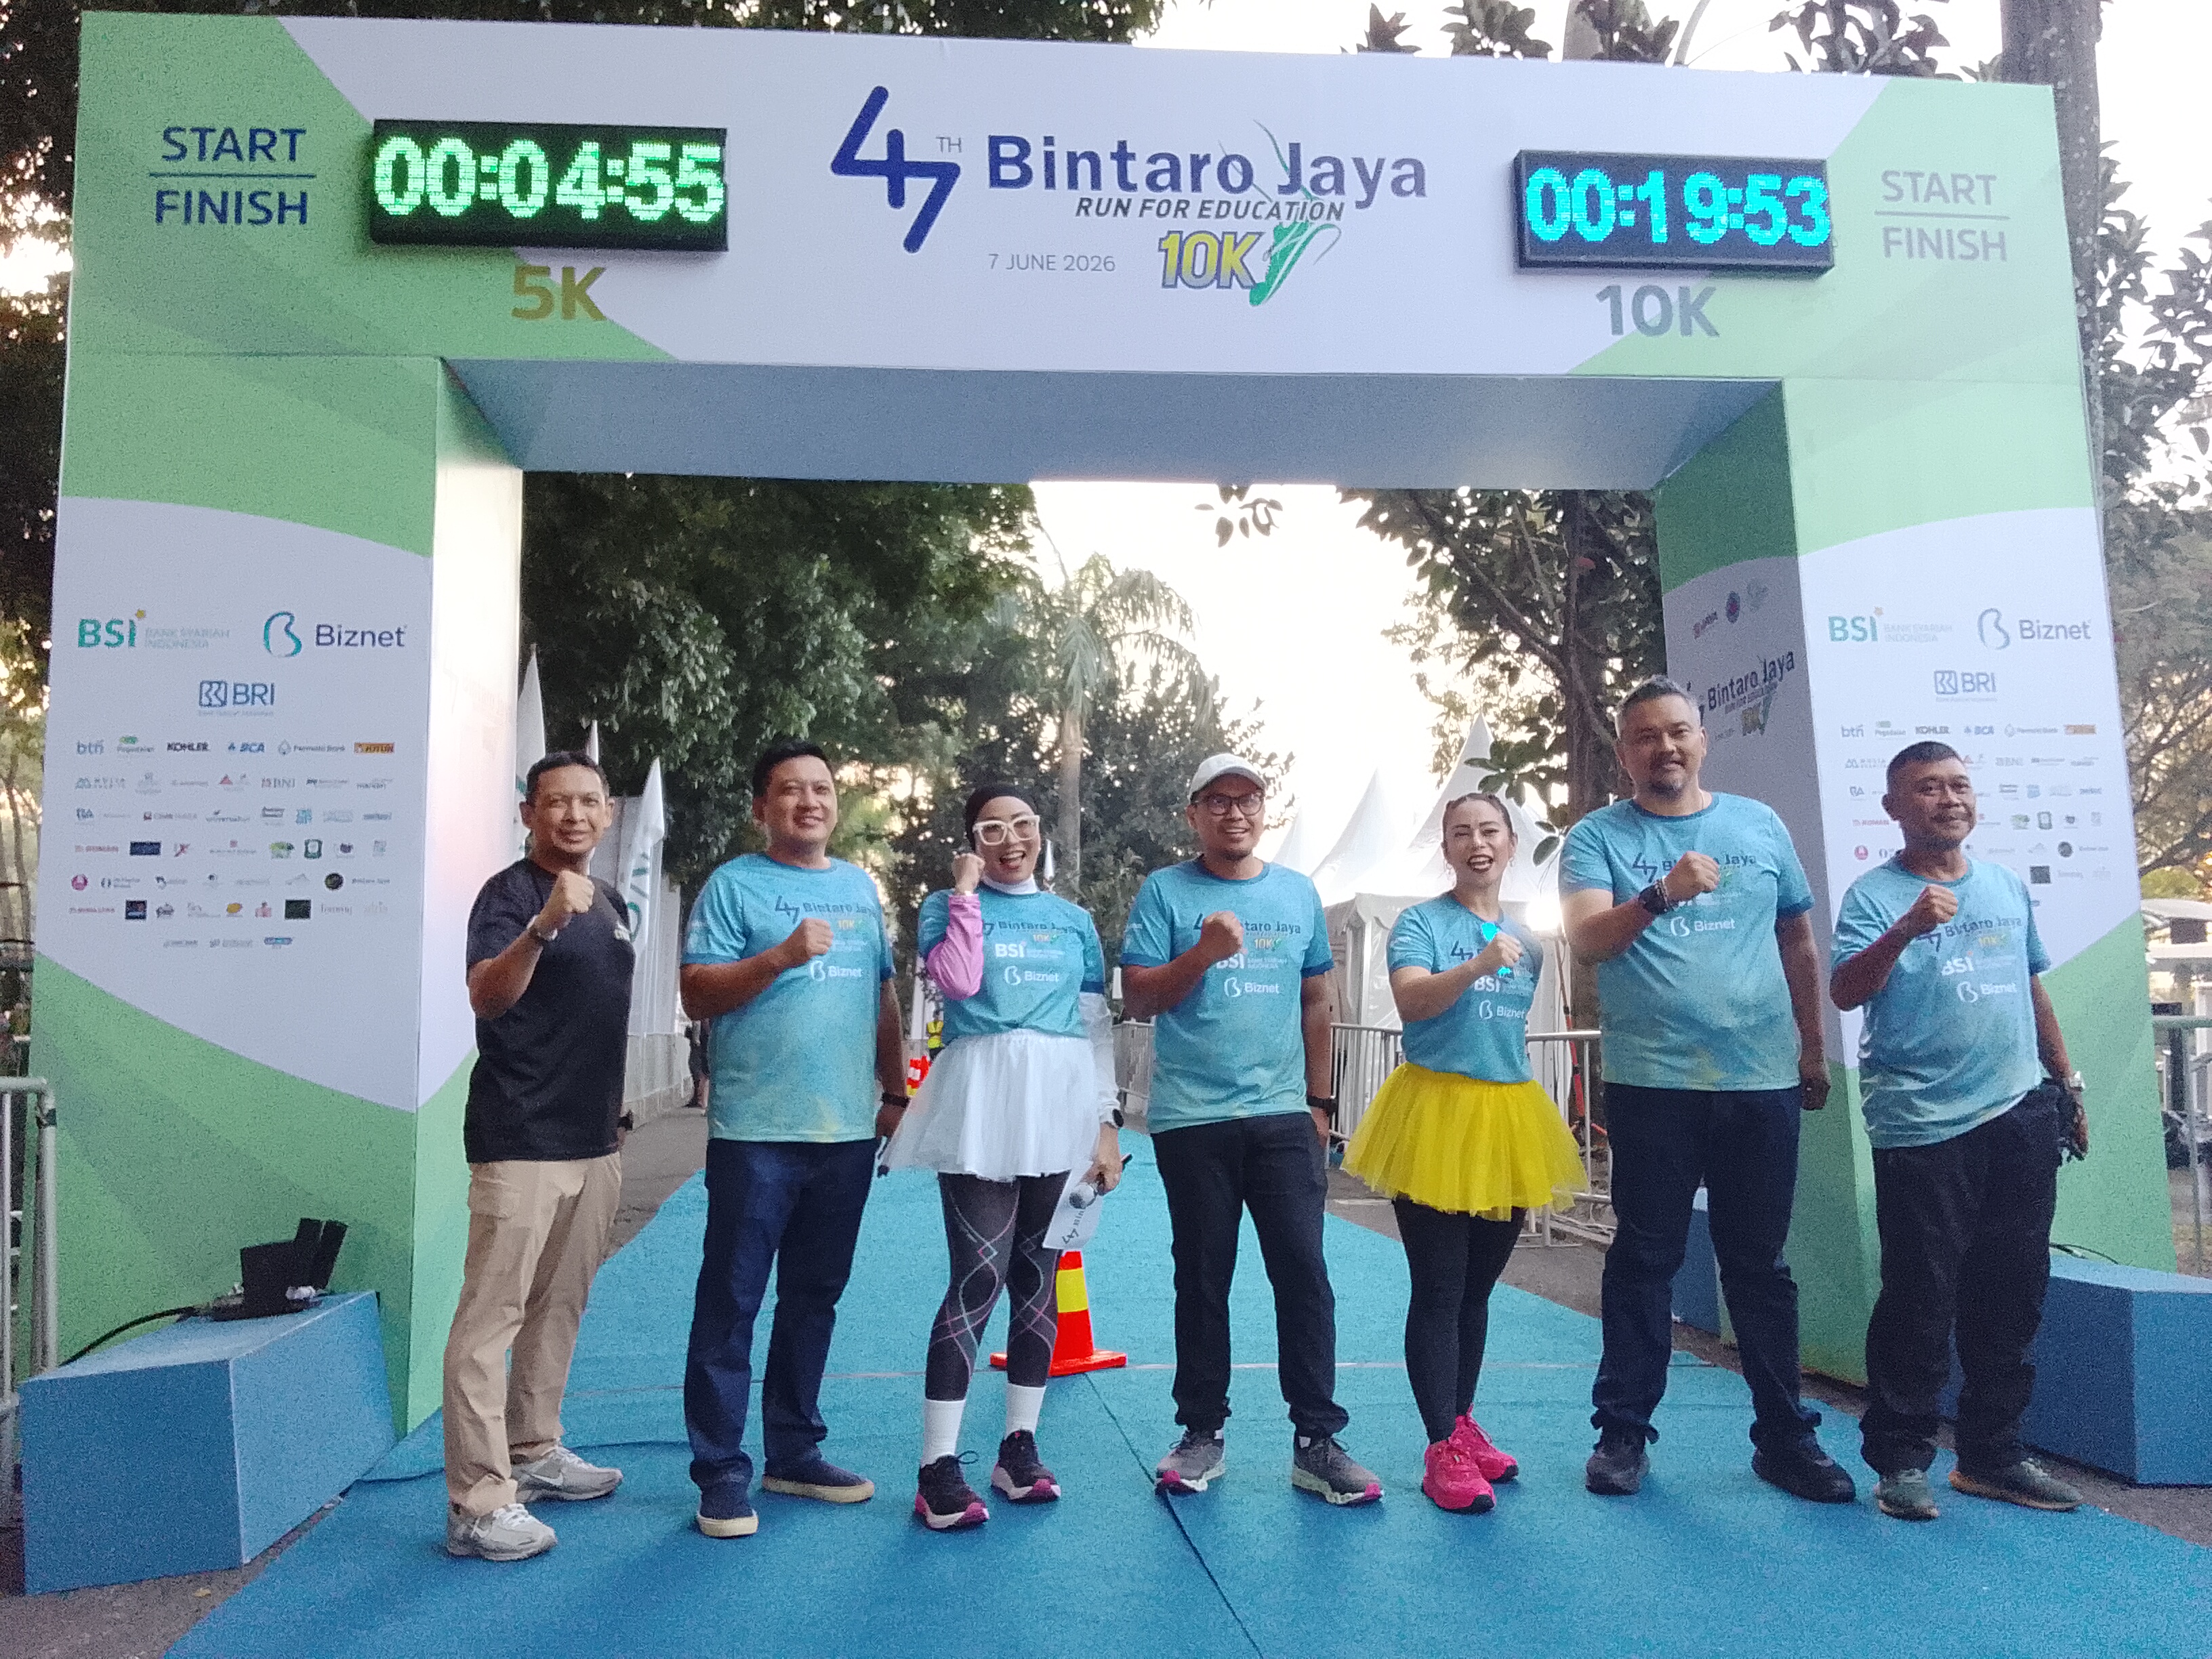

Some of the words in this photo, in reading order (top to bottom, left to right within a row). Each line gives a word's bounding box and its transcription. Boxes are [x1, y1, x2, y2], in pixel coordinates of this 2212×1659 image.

[161, 126, 307, 163] START
[373, 136, 725, 223] 00:04:55
[988, 134, 1255, 194] Bintaro
[1276, 142, 1428, 209] Jaya
[1881, 169, 1998, 205] START
[155, 190, 308, 226] FINISH
[1075, 197, 1133, 219] RUN
[1138, 199, 1190, 220] FOR
[1197, 199, 1345, 222] EDUCATION
[1525, 167, 1832, 247] 00:19:53
[1883, 227, 2008, 262] FINISH
[987, 254, 999, 270] 7
[1006, 254, 1059, 272] JUNE
[1063, 255, 1117, 272] 2026
[1158, 230, 1263, 289] 10K
[511, 265, 607, 322] 5K
[1595, 284, 1720, 338] 10K
[77, 617, 136, 648] BSI
[315, 623, 407, 648] Biznet
[1828, 615, 1879, 642] BSI
[2018, 619, 2092, 640] Biznet
[1707, 671, 1759, 711] Bintaro
[1763, 651, 1795, 682] Jaya
[1961, 672, 1996, 693] BRI
[232, 682, 274, 705] BRI
[998, 920, 1048, 931] Bintaro
[1275, 920, 1302, 935] Jaya
[1694, 918, 1736, 932] Biznet
[995, 943, 1025, 958] BSI
[1254, 938, 1272, 949] 10K
[828, 966, 863, 978] Biznet
[1024, 970, 1060, 983] Biznet
[1473, 975, 1500, 993] BSI
[1244, 983, 1280, 994] Biznet
[1980, 983, 2018, 996] Biznet
[1496, 1005, 1525, 1019] Biznet
